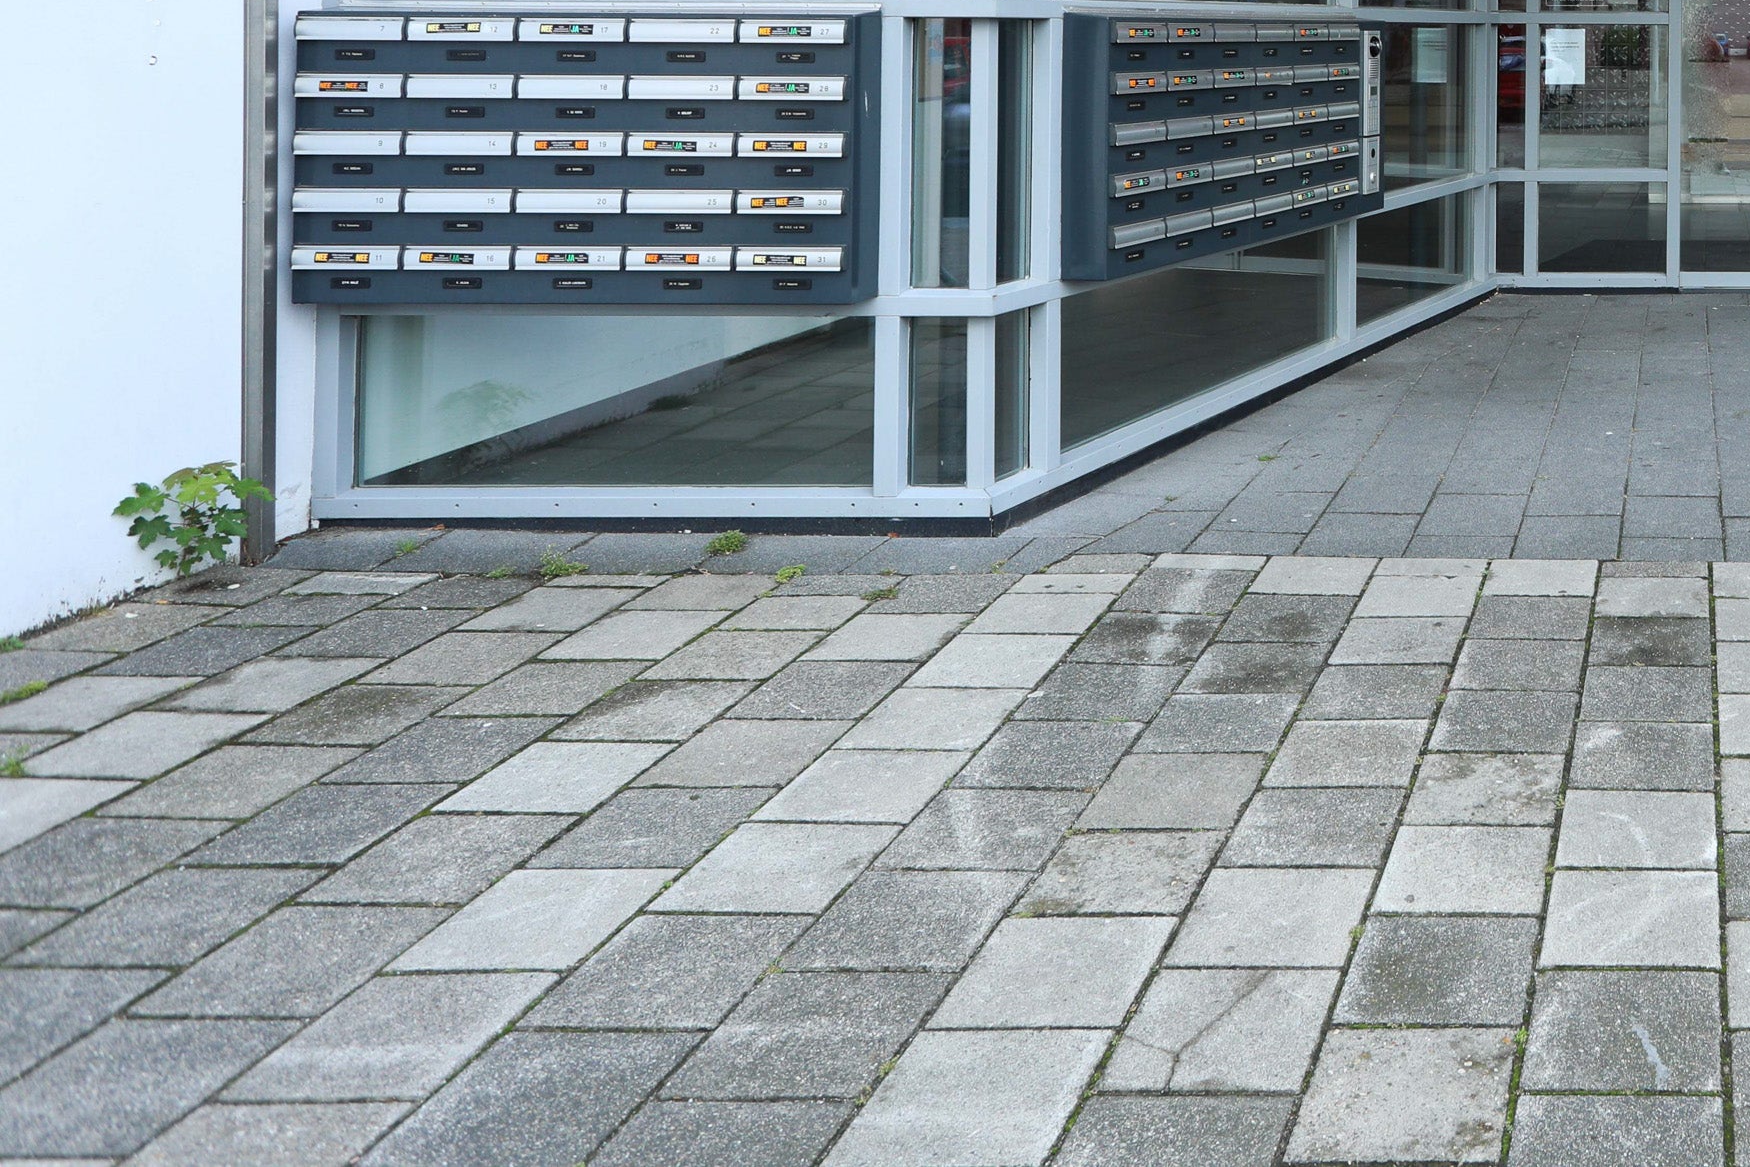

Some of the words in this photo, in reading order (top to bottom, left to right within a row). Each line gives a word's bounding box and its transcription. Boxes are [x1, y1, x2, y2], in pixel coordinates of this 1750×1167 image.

[427, 23, 440, 32] NEE
[467, 22, 480, 31] NEE
[541, 25, 553, 33] NEE
[571, 25, 579, 33] JA
[759, 27, 772, 36] NEE
[789, 27, 798, 35] JA
[320, 82, 332, 90] NEE
[345, 81, 358, 89] NEE
[757, 84, 769, 92] NEE
[787, 84, 796, 92] JA
[535, 141, 548, 150] NEE
[575, 140, 588, 150] NEE
[644, 141, 656, 150] NEE
[674, 142, 683, 150] JA
[754, 142, 767, 150] NEE
[793, 142, 806, 150] NEE
[752, 198, 764, 207] NEE
[776, 197, 788, 206] NEE
[315, 253, 328, 262] NEE
[355, 253, 369, 262] NEE
[420, 253, 433, 262] NEE
[451, 254, 460, 262] JA
[536, 254, 548, 262] NEE
[566, 254, 575, 262] JA
[646, 254, 658, 263] NEE
[686, 254, 698, 263] NEE
[754, 255, 767, 264] NEE
[793, 256, 806, 265] NEE
